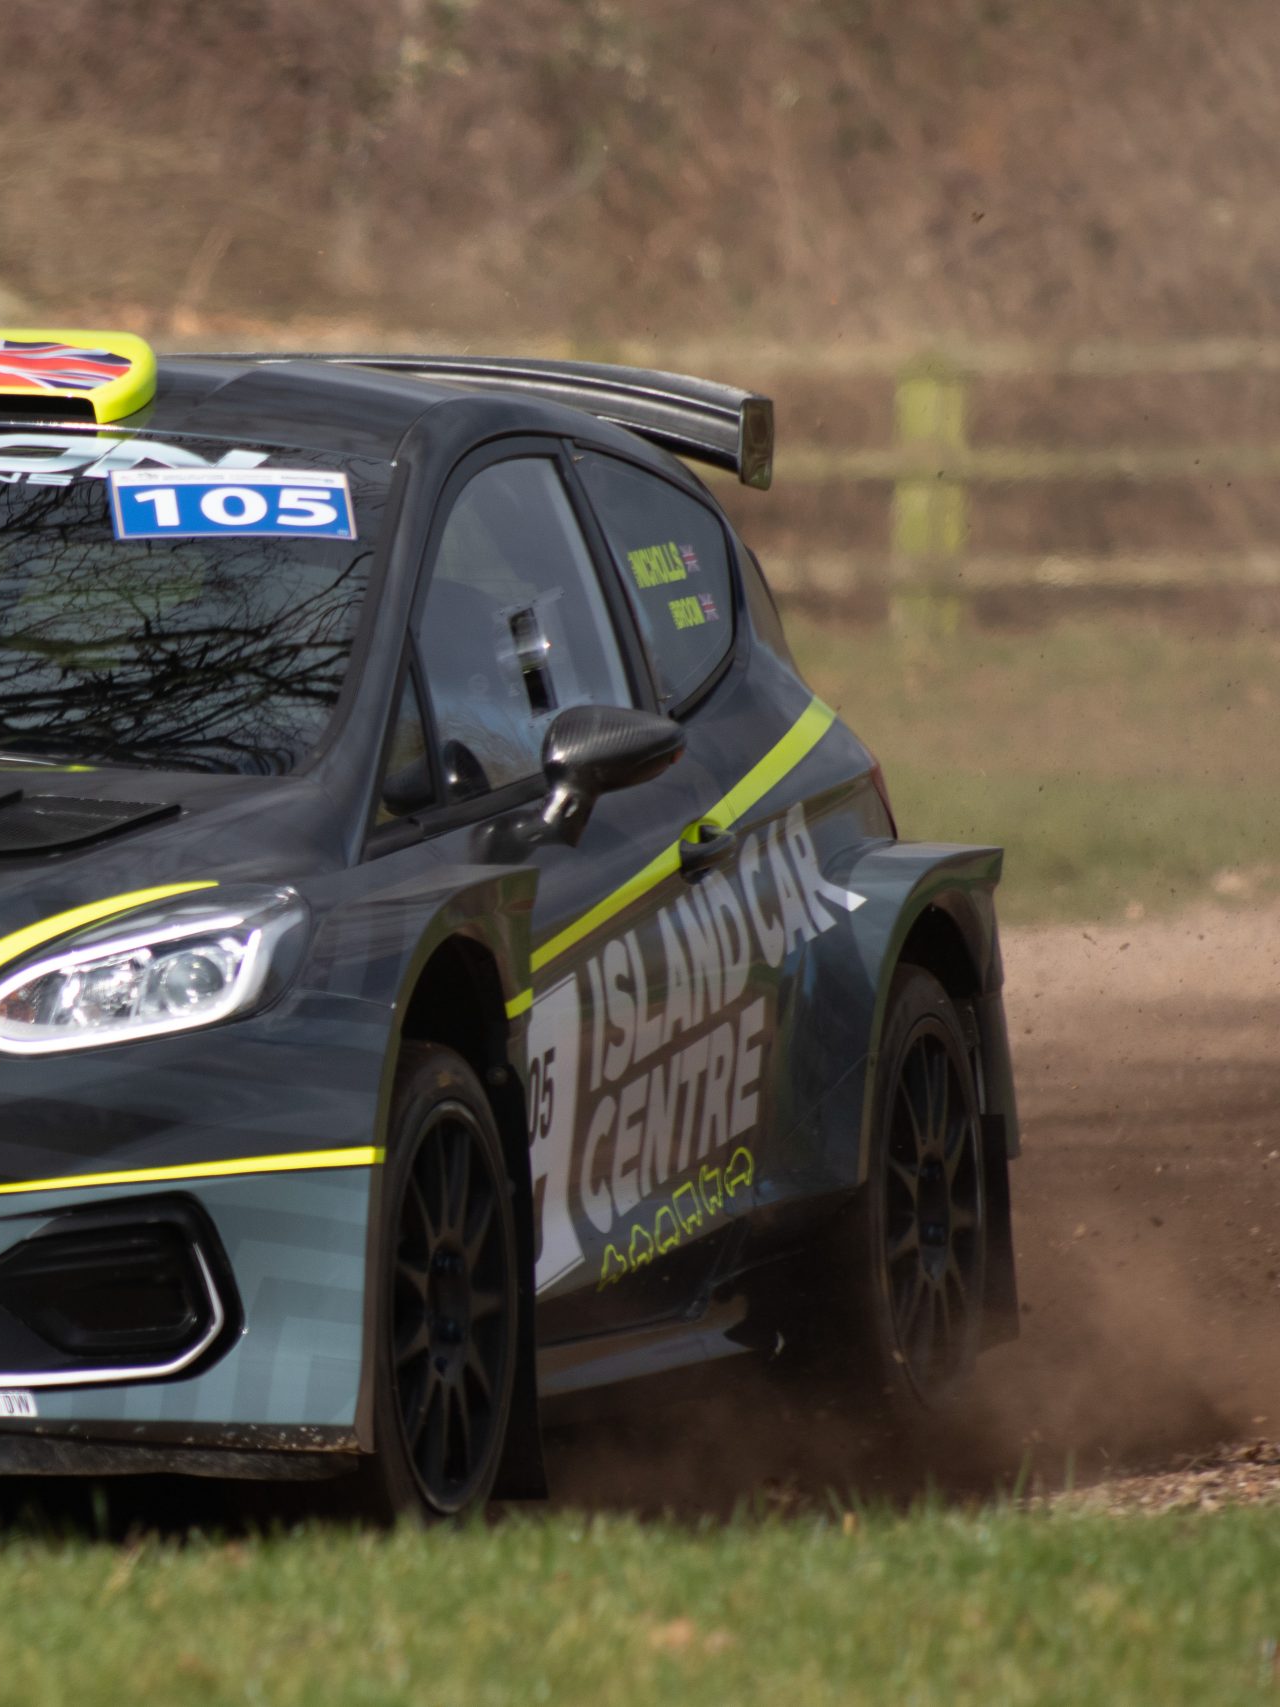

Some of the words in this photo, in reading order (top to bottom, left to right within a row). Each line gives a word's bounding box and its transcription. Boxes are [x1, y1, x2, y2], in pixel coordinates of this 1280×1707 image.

[134, 486, 338, 527] 105
[587, 870, 751, 1092] ISLAND
[738, 801, 867, 969] CAR
[529, 1046, 556, 1147] 05
[581, 998, 766, 1234] CENTRE
